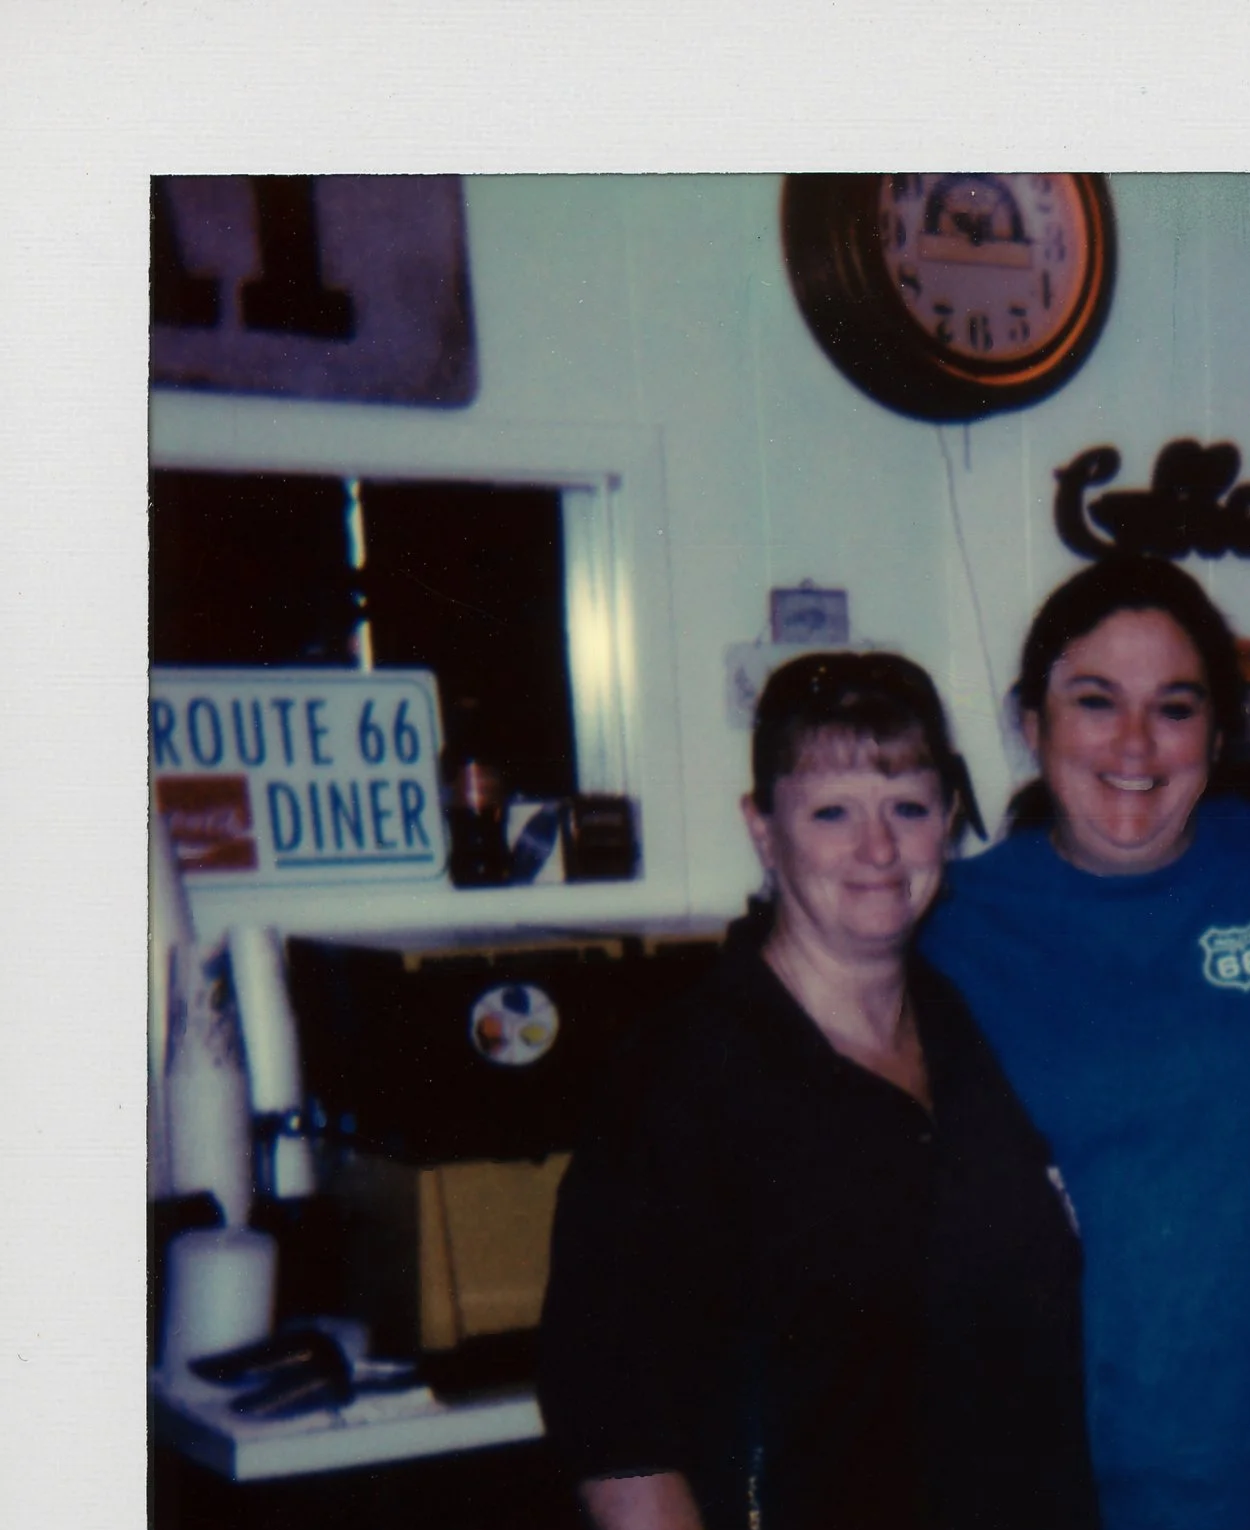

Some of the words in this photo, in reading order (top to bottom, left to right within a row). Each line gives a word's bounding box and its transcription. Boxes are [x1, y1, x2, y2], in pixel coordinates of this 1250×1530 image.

[151, 695, 334, 768] ROUTE
[358, 696, 421, 766] 66
[266, 779, 430, 852] DINER
